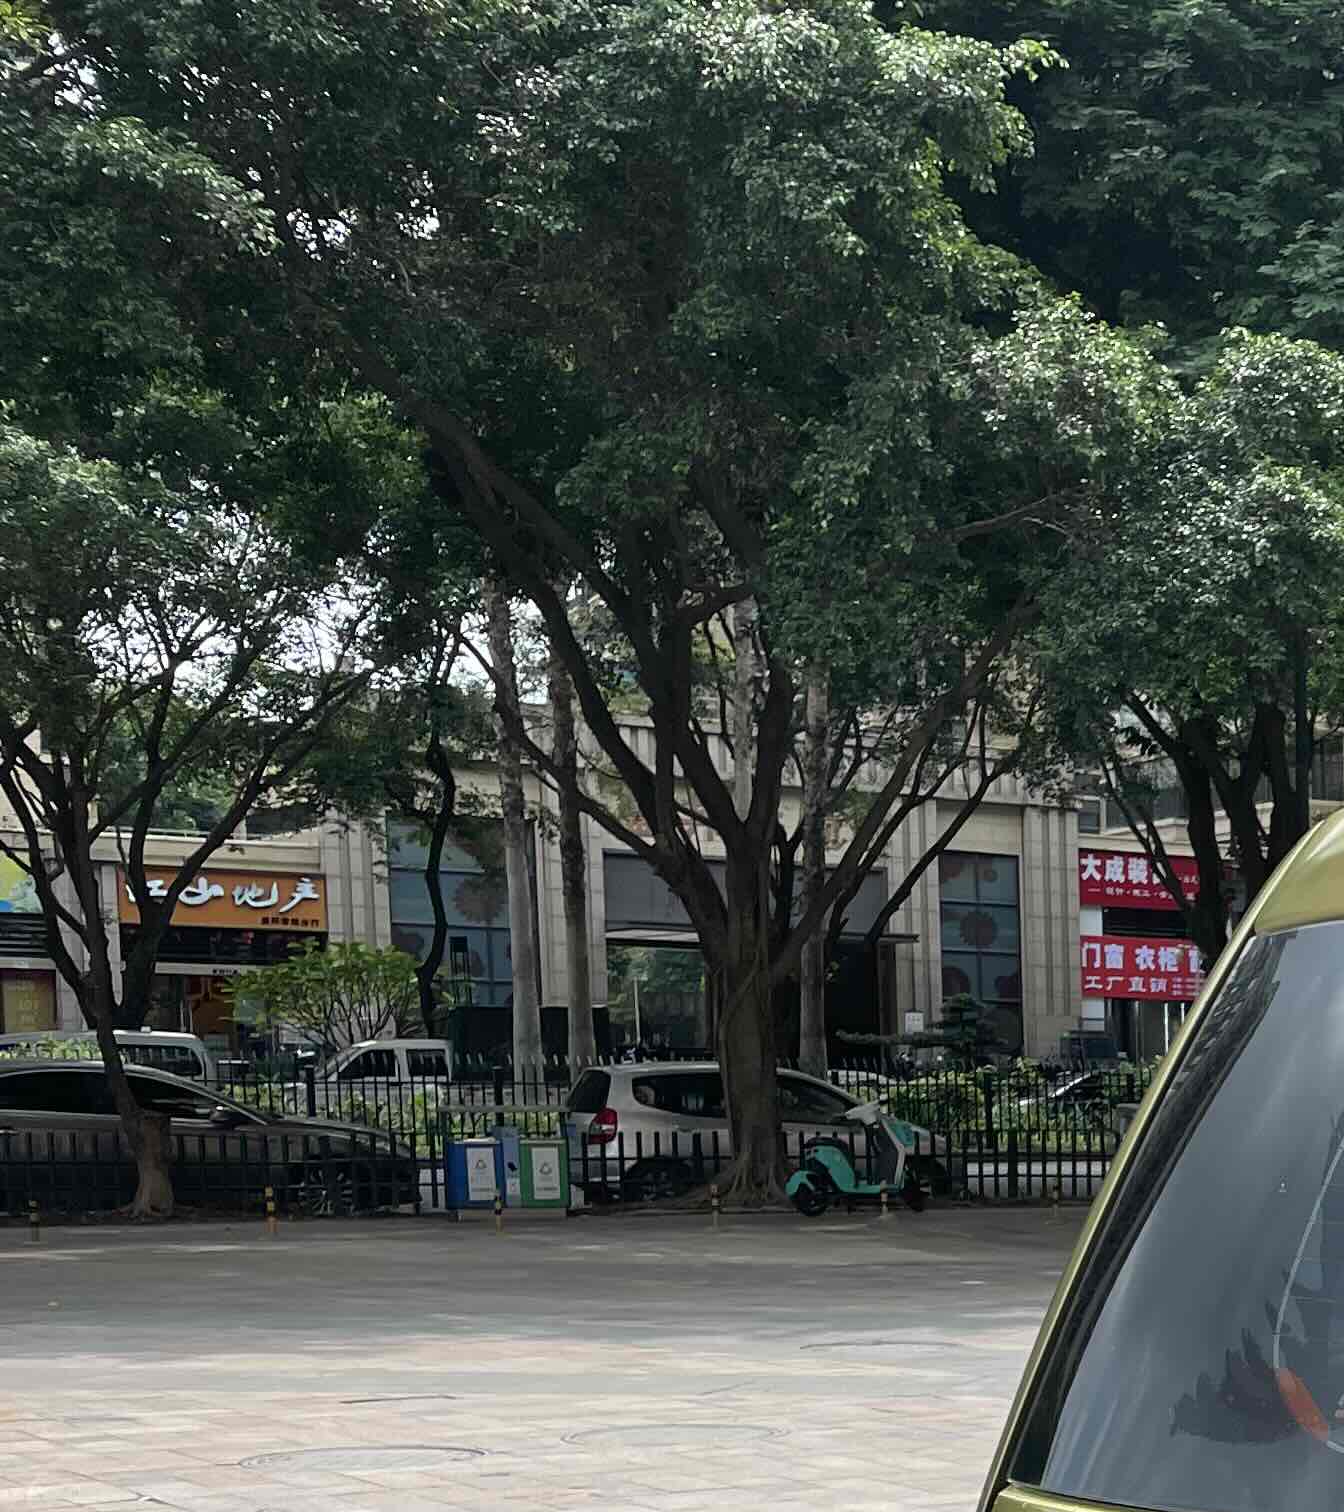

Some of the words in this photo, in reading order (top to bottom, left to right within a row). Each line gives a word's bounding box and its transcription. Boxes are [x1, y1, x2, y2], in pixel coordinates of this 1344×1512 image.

[1079, 853, 1163, 885] 大成装
[1080, 941, 1125, 970] 门窗
[1134, 944, 1179, 973] 衣柜
[1084, 975, 1168, 993] 工厂直销
